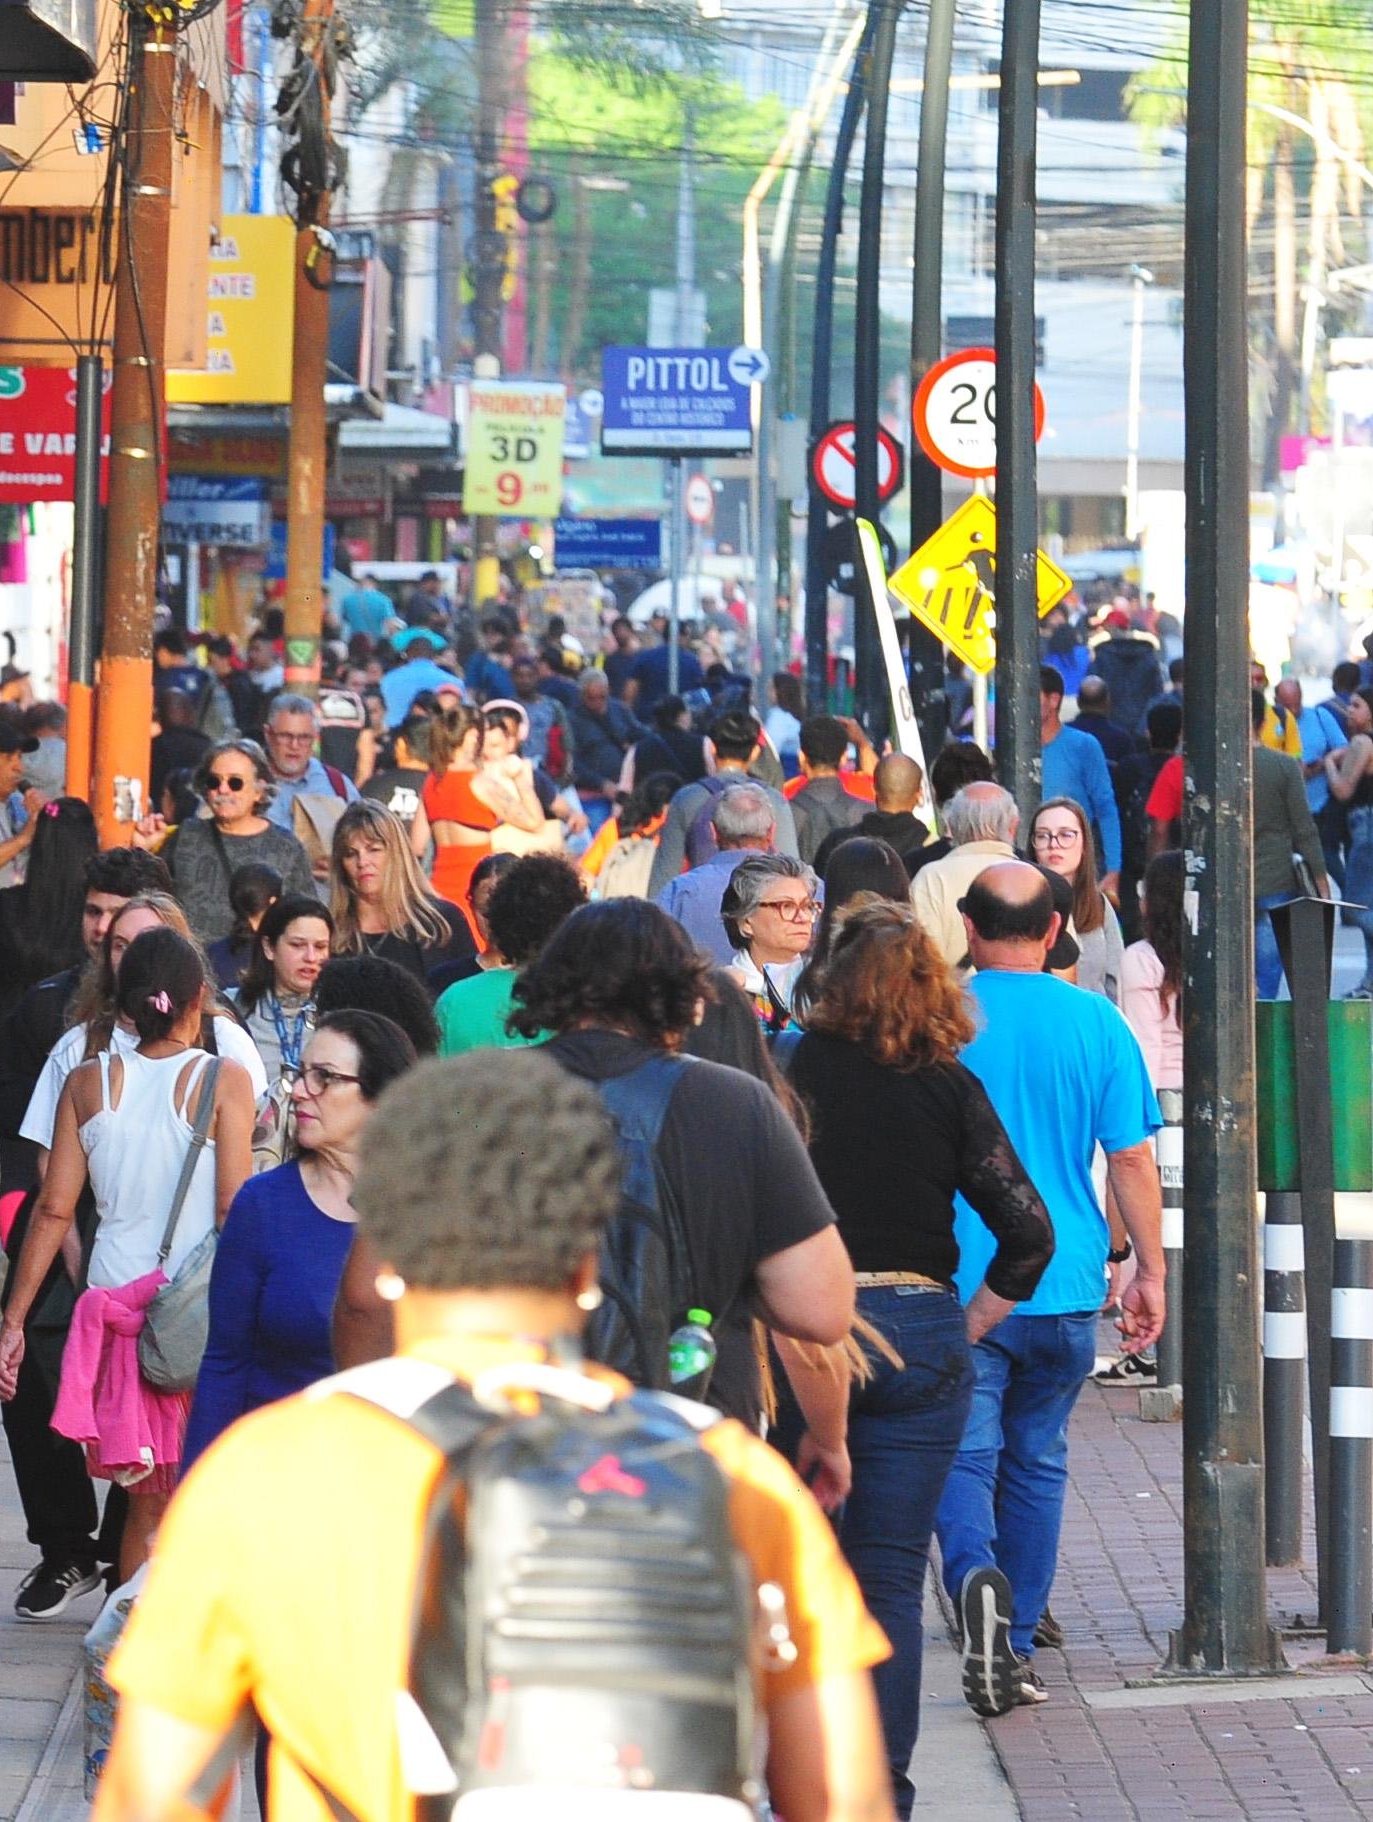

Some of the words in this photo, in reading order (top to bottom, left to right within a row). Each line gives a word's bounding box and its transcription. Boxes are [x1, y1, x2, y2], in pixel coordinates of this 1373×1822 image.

[627, 356, 728, 391] PITTOL
[491, 436, 537, 462] 3D
[496, 472, 522, 506] 9
